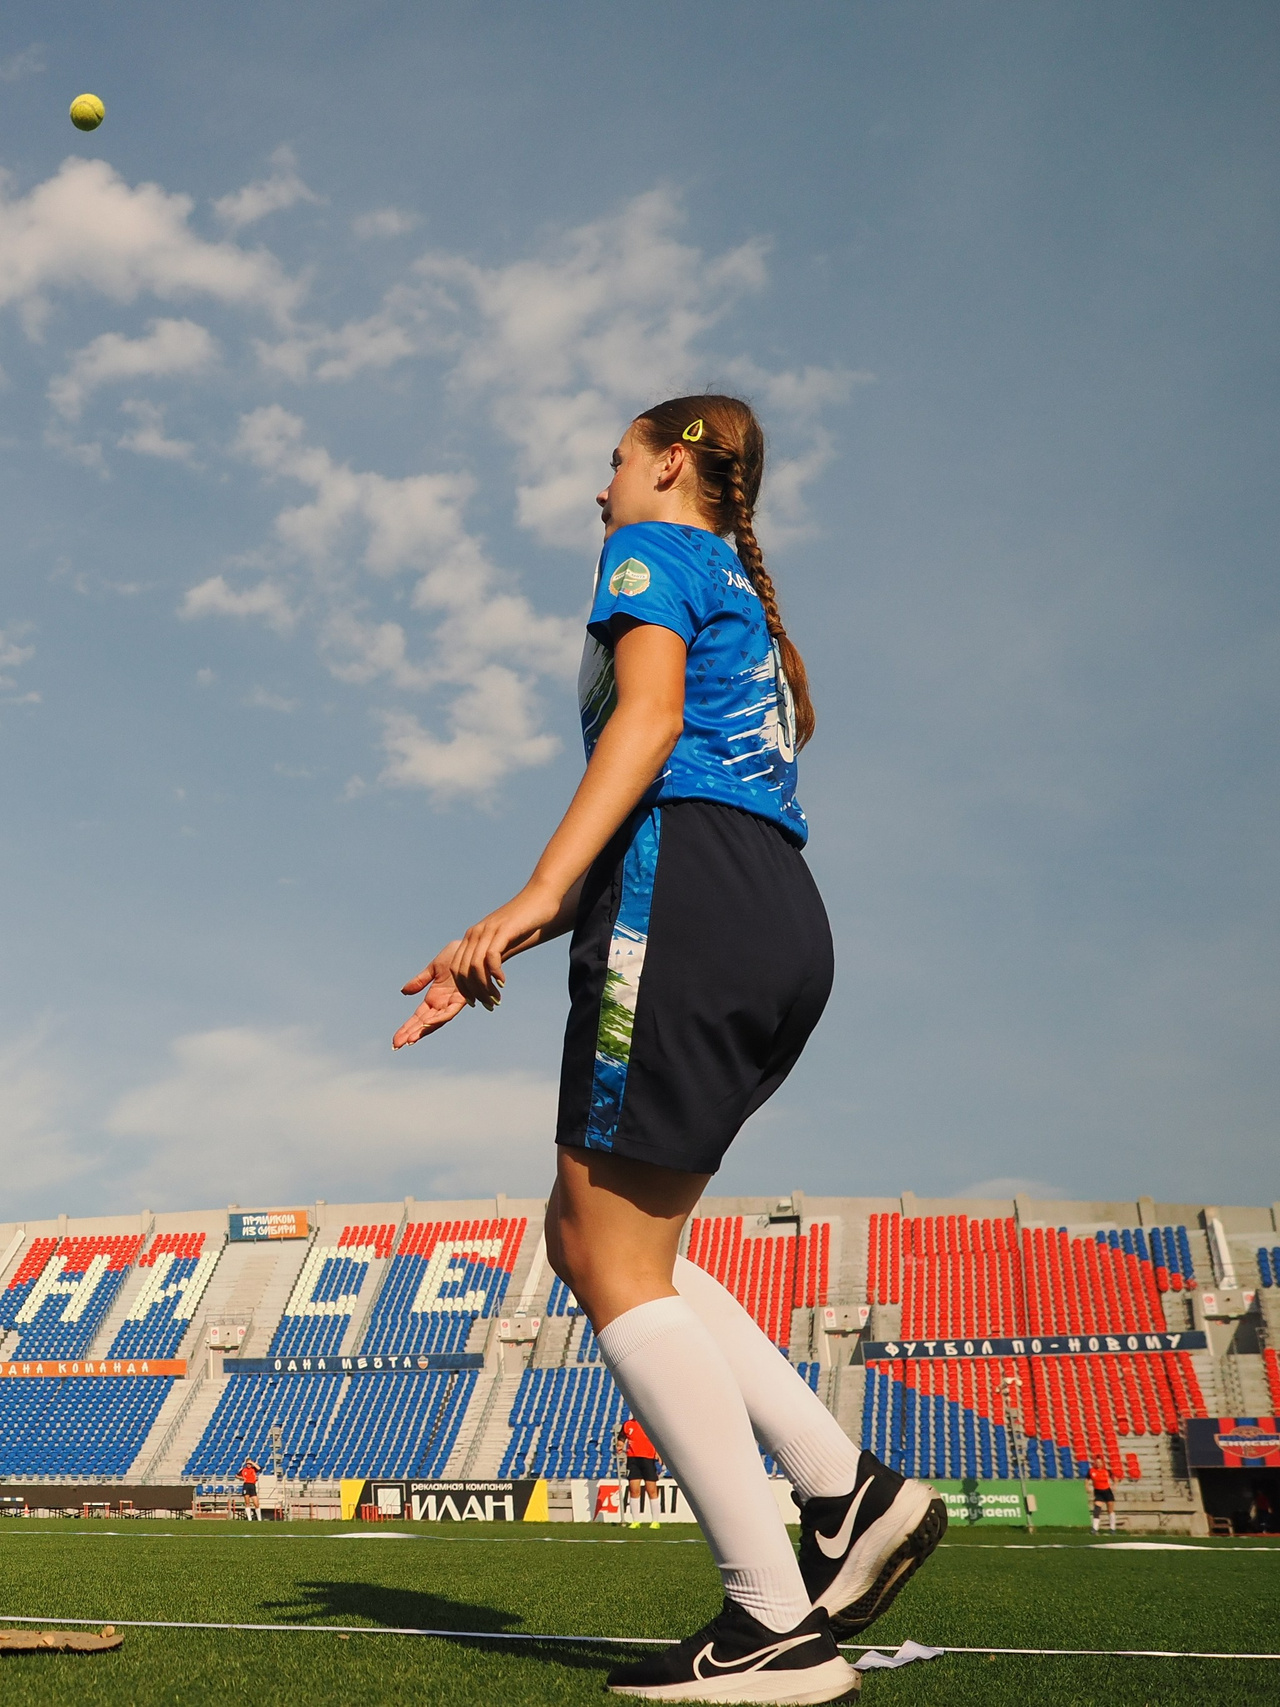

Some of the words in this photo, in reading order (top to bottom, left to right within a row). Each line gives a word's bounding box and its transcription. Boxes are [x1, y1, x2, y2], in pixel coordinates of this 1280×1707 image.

[242, 1214, 296, 1226] ПРЯМИКОМ
[242, 1226, 257, 1236] ИЗ
[257, 1225, 296, 1236] СИБИРИ
[884, 1339, 994, 1357] ФУТБОЛ
[1012, 1334, 1181, 1353] ПО-НОВОМУ
[58, 1361, 149, 1374] КОМАНДА
[274, 1358, 326, 1372] ОДНА
[411, 1484, 464, 1492] рекламная
[465, 1483, 513, 1492] компания
[940, 1492, 1019, 1506] Пятёрочка
[411, 1495, 515, 1521] ИЛАН
